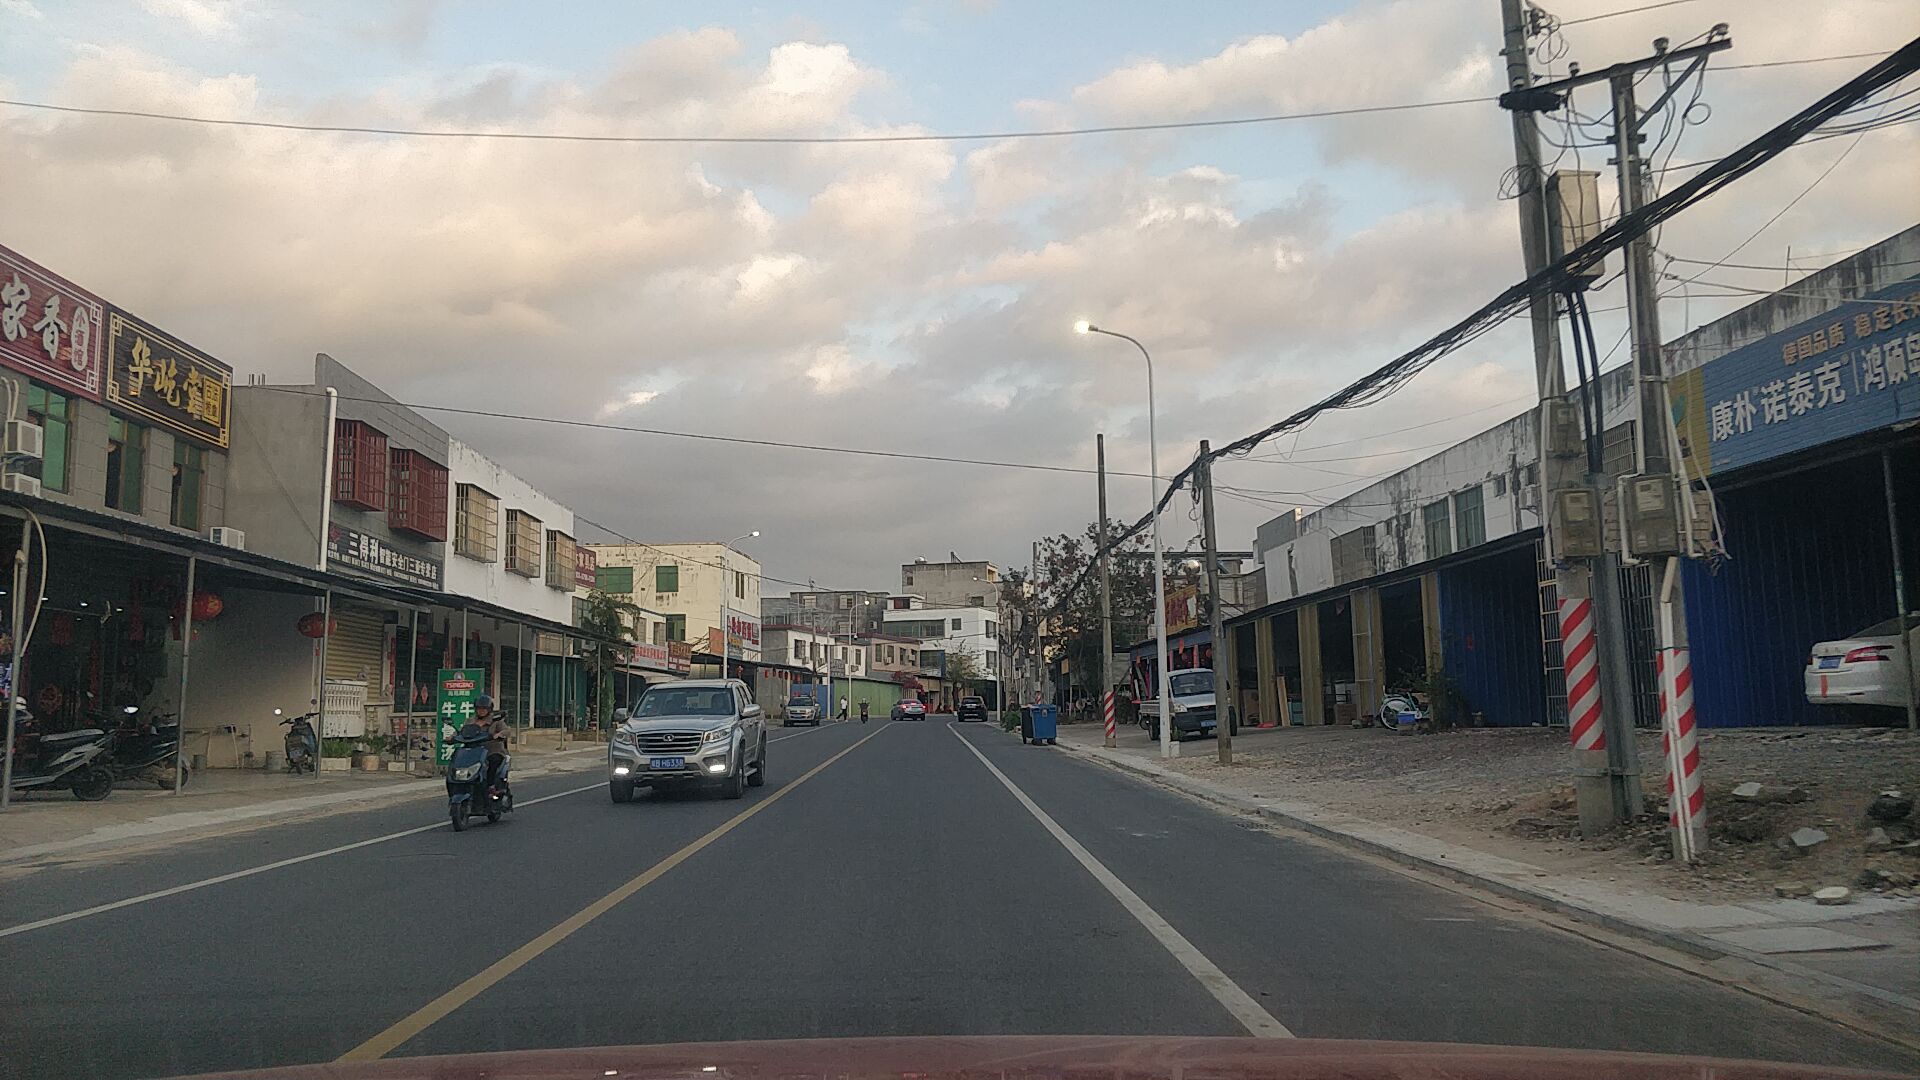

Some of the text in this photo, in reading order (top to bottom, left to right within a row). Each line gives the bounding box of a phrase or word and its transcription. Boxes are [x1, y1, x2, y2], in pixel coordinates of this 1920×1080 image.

[1711, 390, 1757, 442] 康朴
[1761, 360, 1846, 425] 诺泰克
